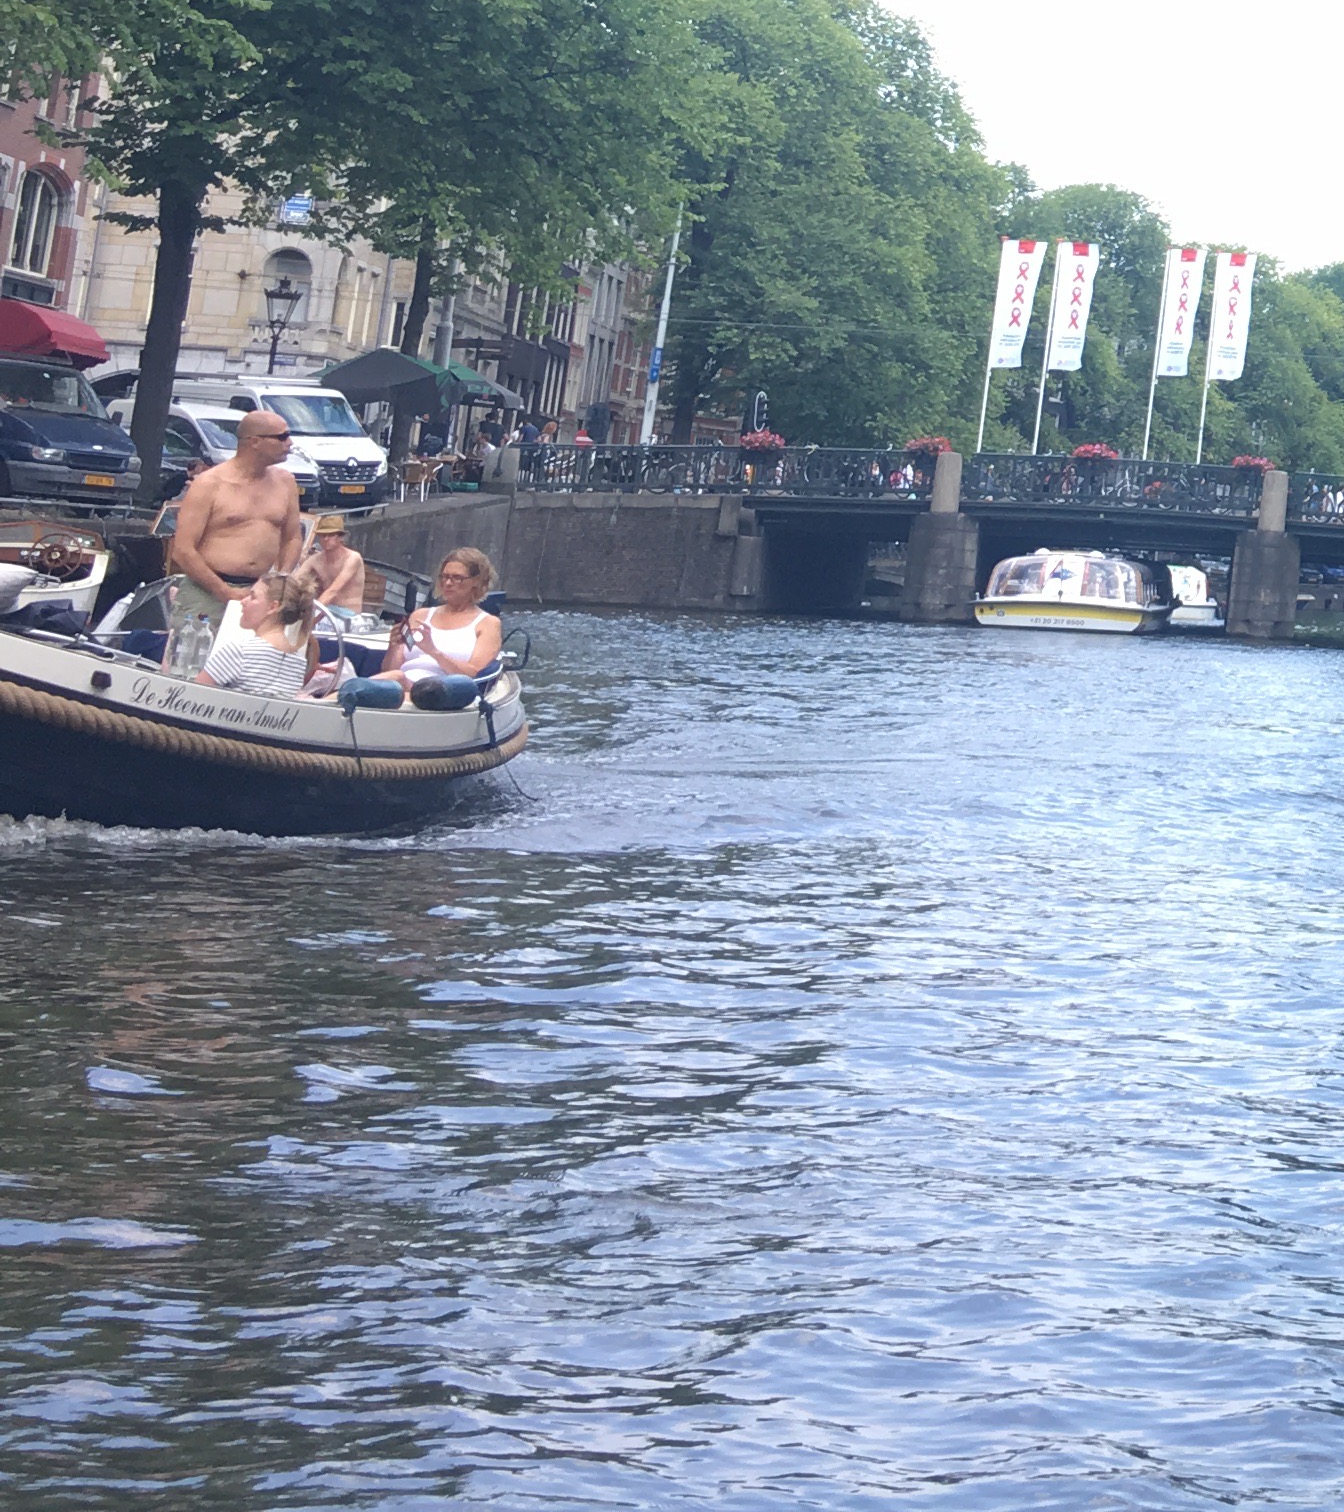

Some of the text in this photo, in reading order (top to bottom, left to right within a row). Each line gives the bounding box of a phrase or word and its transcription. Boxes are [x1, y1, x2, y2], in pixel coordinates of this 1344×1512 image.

[130, 675, 300, 732] De Heeren van Amstel
